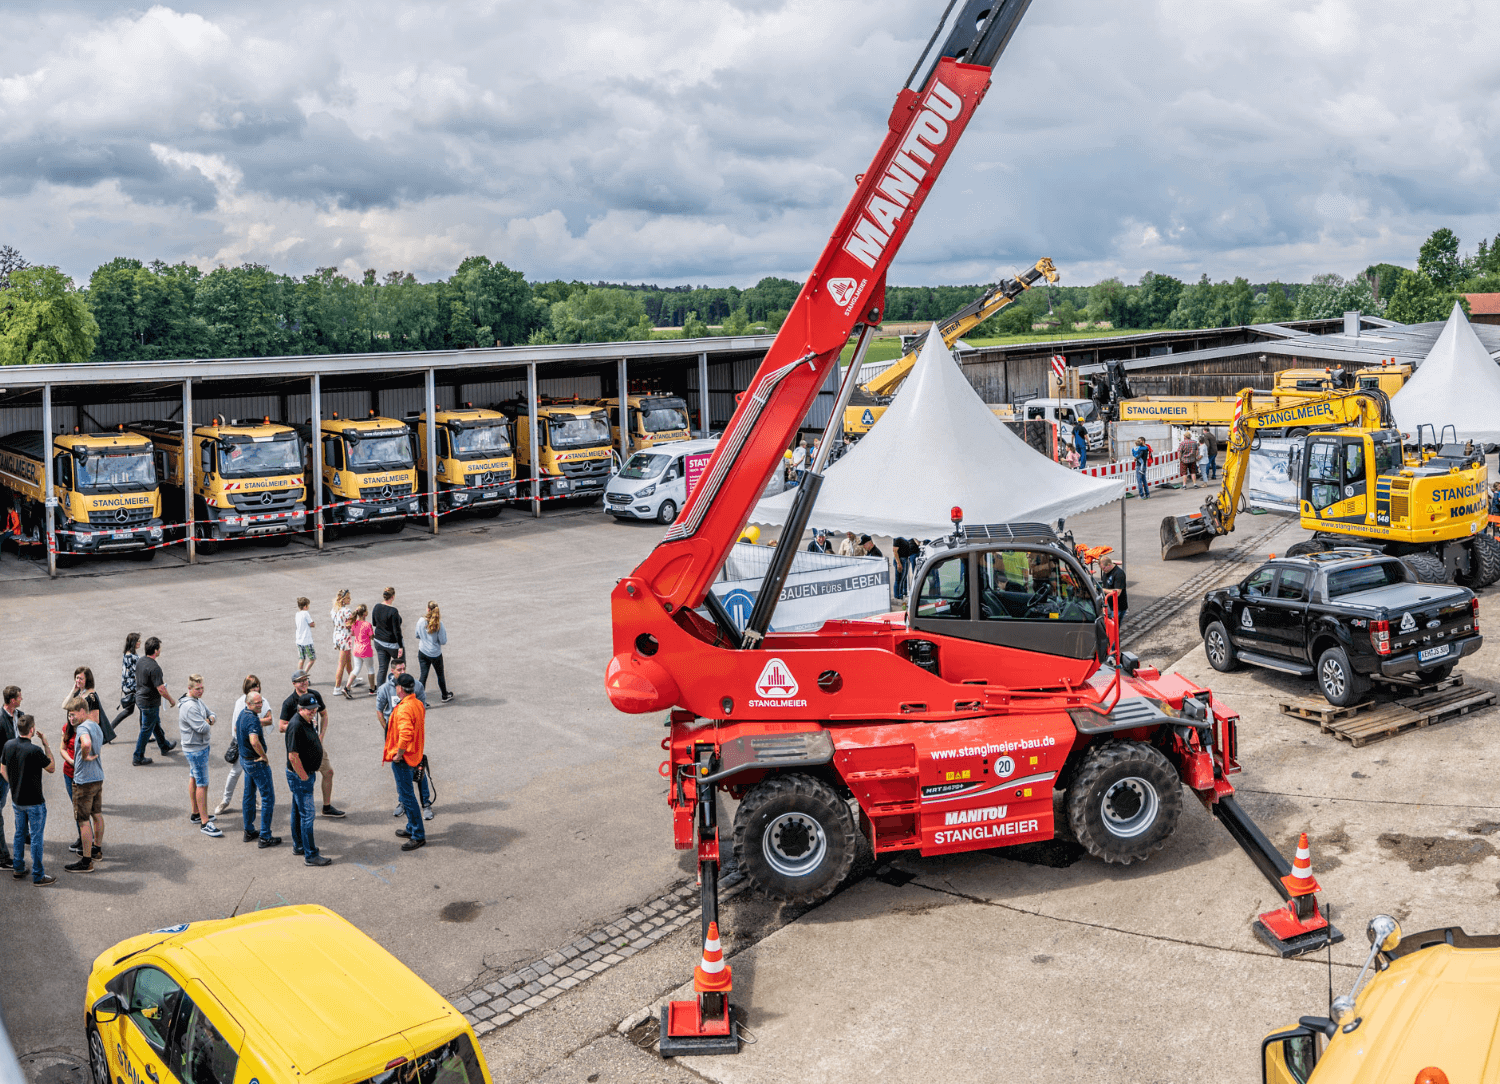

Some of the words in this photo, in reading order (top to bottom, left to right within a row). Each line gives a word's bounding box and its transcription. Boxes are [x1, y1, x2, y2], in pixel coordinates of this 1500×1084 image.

[845, 77, 963, 270] MANITOU
[844, 278, 868, 316] STANGLMEIER
[1127, 406, 1188, 415] STANGLMEIER
[1257, 403, 1332, 427] STANGLMEIER
[653, 432, 685, 440] STANGLMEIER
[567, 450, 605, 459] STANGLMEIER
[467, 461, 509, 471] STANGLMEIER
[689, 458, 710, 468] STATI
[244, 480, 288, 489] STANGLMEIER
[363, 474, 409, 484] STANGLMEIER
[1432, 478, 1487, 502] STANGLME
[92, 497, 149, 508] STANGLMEIER
[1321, 520, 1390, 535] www.stanglmeier-bau.de
[779, 584, 818, 601] BAUEN
[821, 582, 842, 594] FÜRS
[845, 573, 882, 591] LEBEN
[1394, 624, 1472, 649] RANGER
[1421, 651, 1432, 659] KEH
[931, 735, 1055, 760] www.stanglmeier-bau.de
[999, 760, 1011, 773] 20
[945, 805, 1008, 826] MANITOU
[934, 819, 1039, 845] STANGLMEIER
